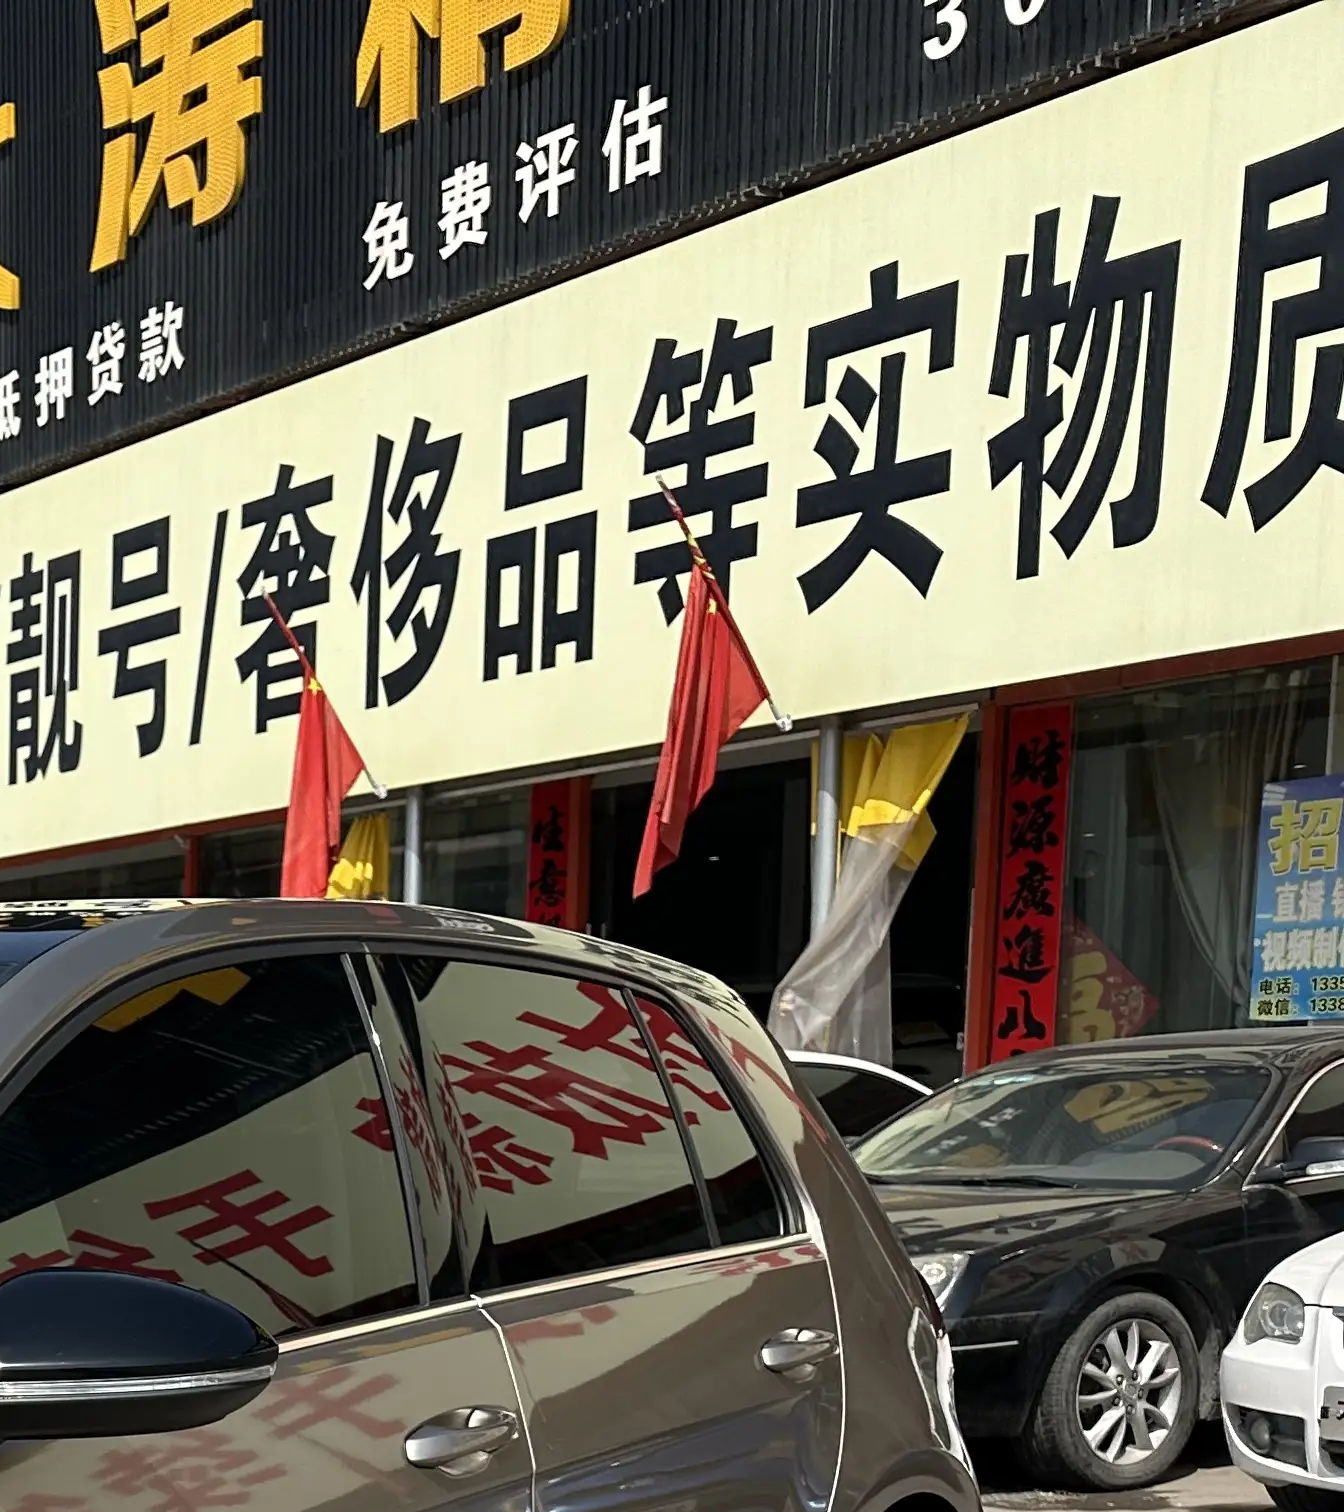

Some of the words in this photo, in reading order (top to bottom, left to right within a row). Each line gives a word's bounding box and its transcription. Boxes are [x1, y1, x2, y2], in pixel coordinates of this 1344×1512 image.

[362, 85, 669, 291] 免费评估
[1268, 799, 1343, 876] 招
